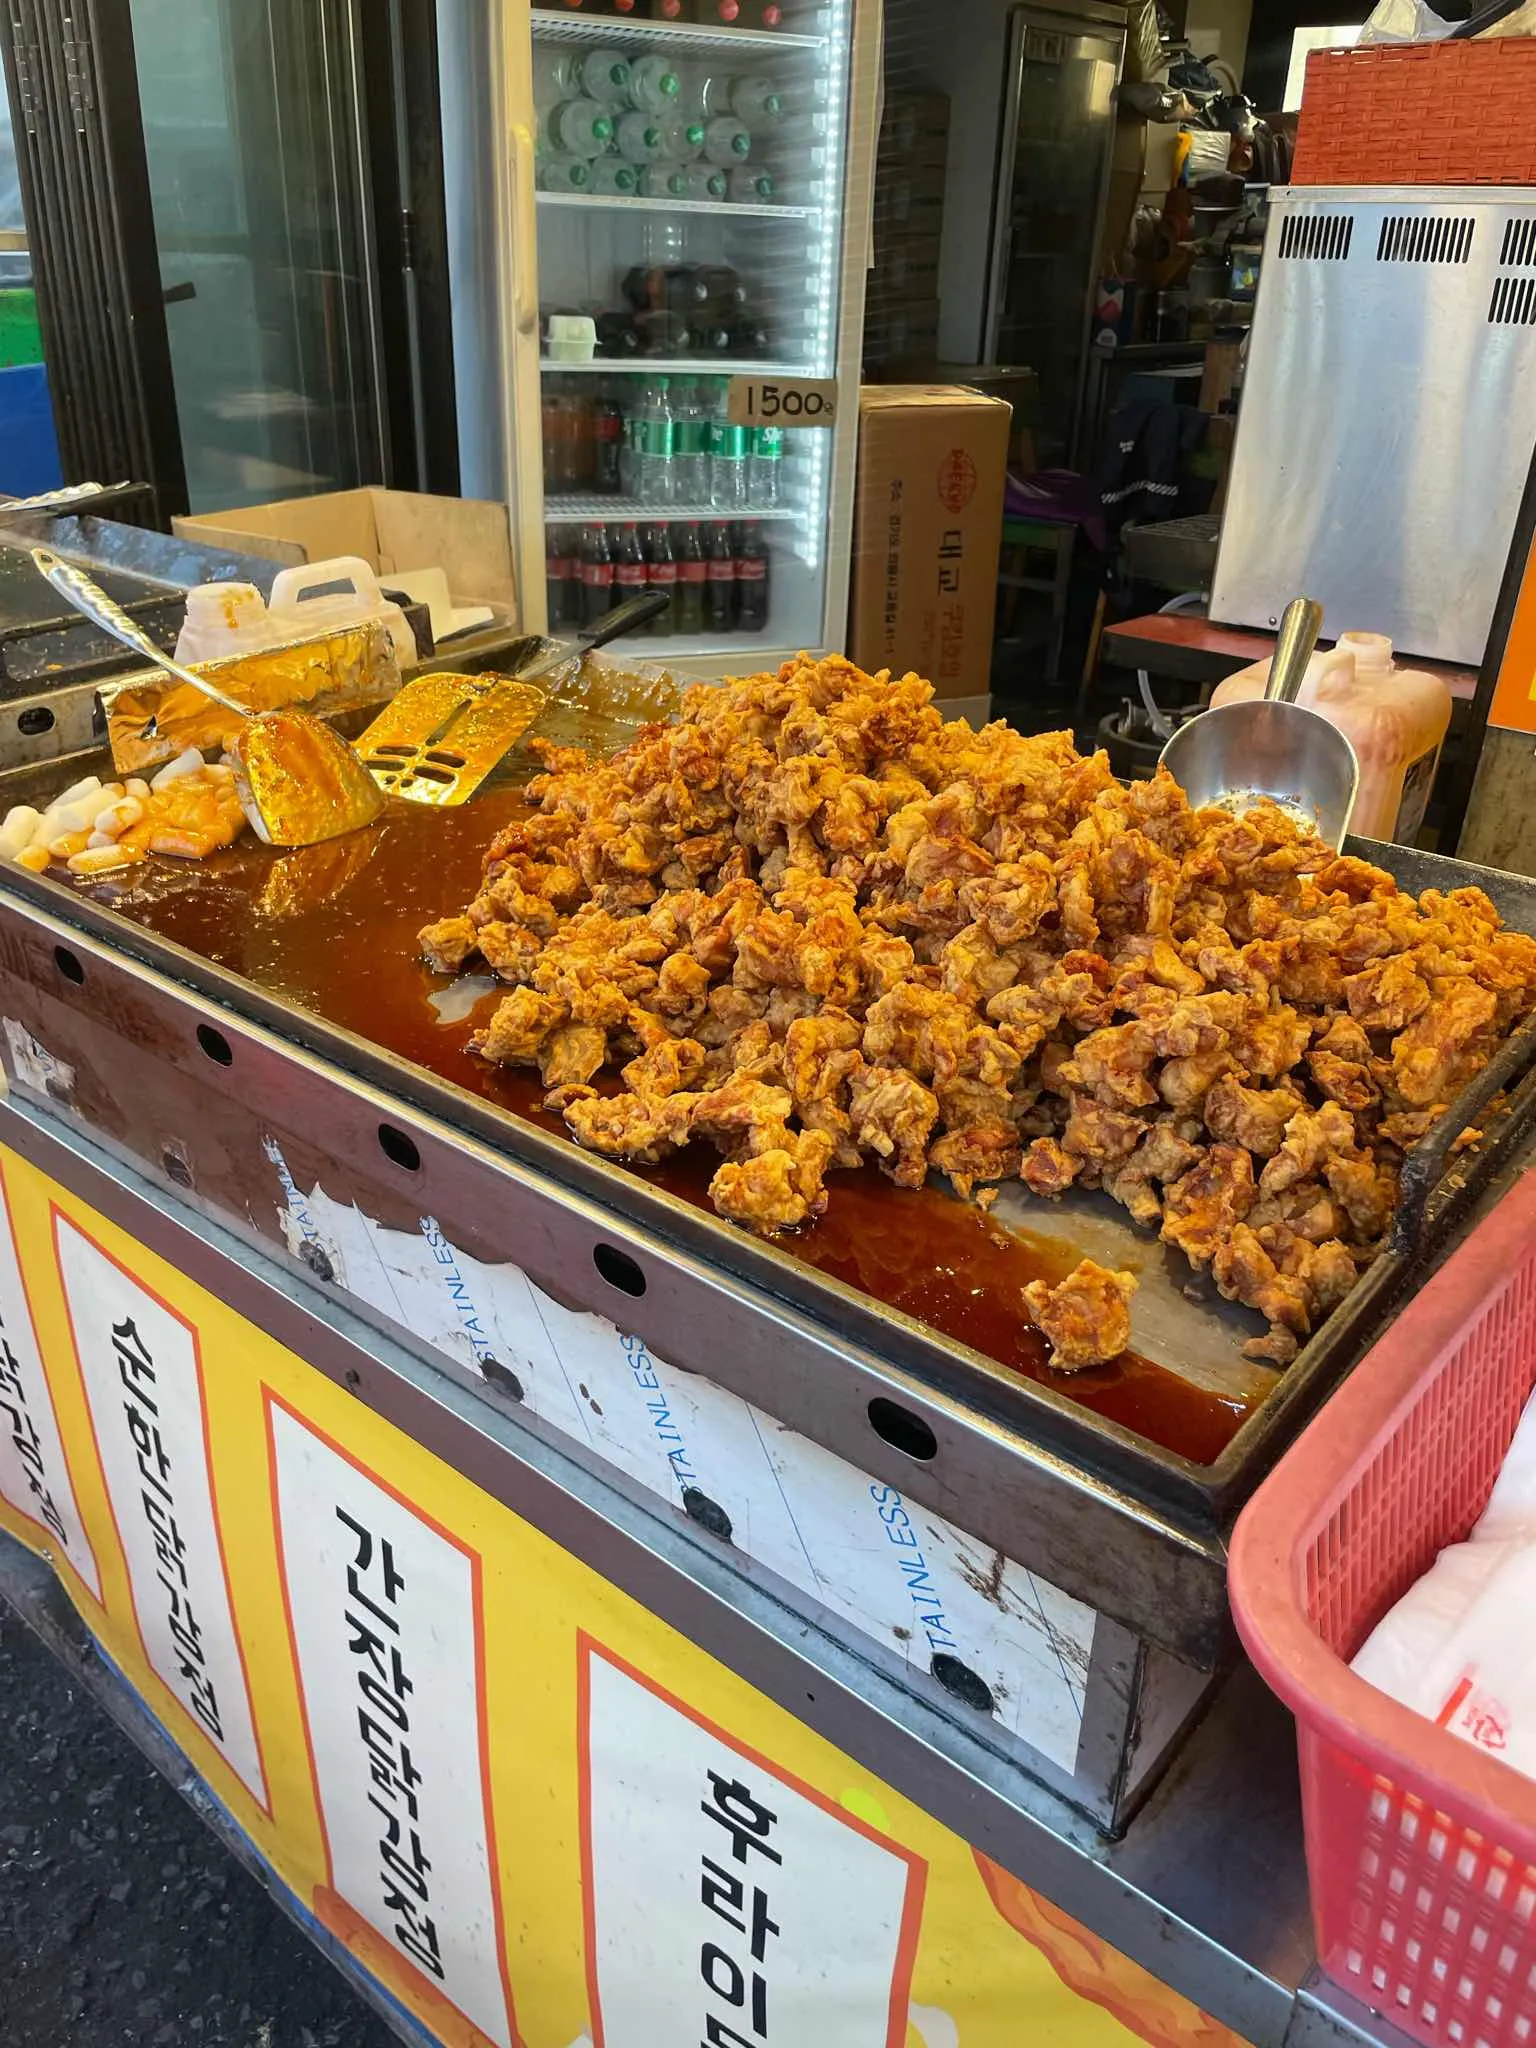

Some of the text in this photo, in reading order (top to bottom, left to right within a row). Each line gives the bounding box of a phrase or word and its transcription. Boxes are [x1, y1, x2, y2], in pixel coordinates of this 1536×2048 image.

[937, 529, 963, 597] 대교
[111, 1315, 224, 1743] 순한닭강정
[335, 1504, 445, 1981] 간장닭강정
